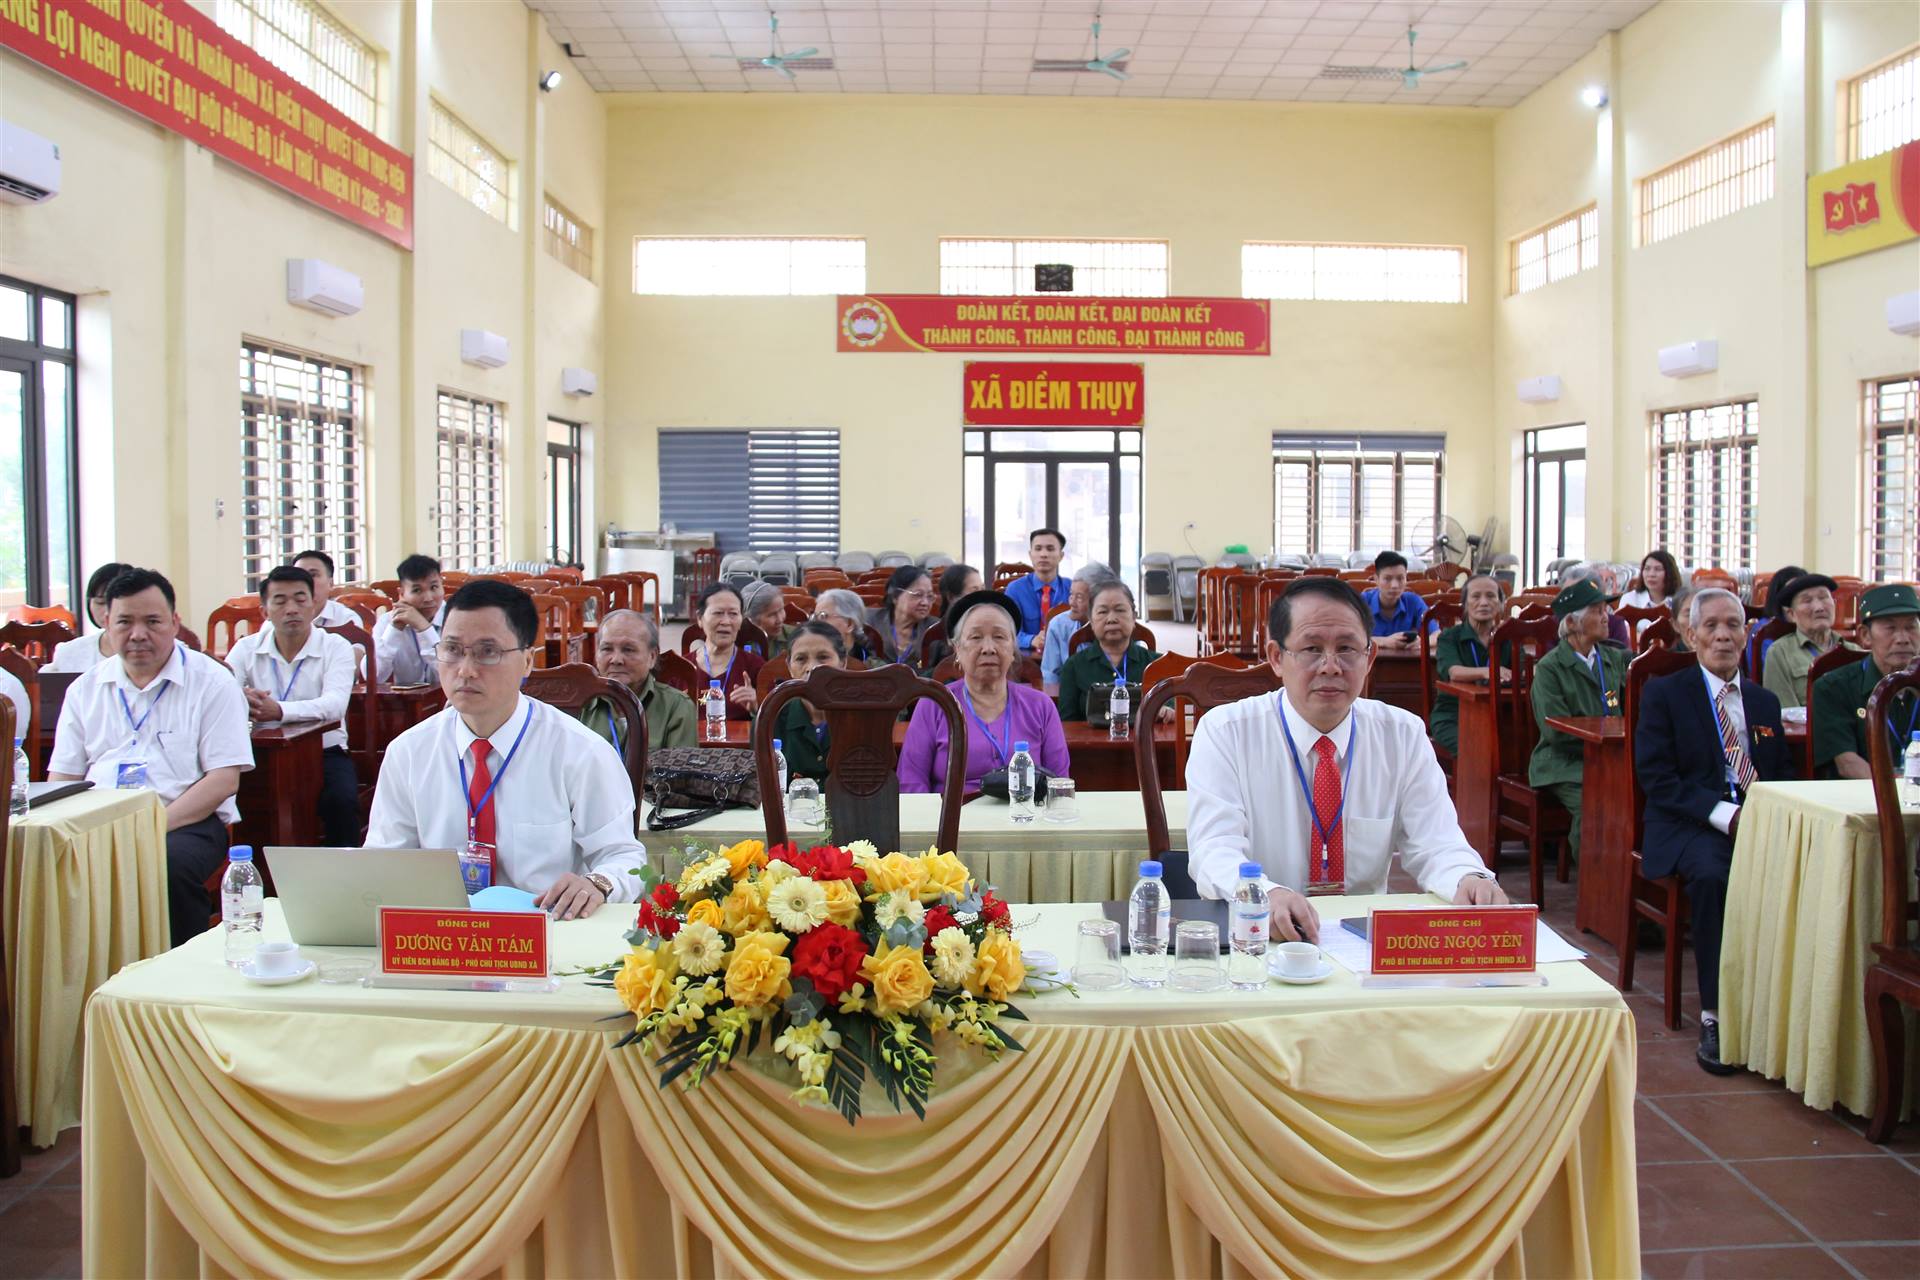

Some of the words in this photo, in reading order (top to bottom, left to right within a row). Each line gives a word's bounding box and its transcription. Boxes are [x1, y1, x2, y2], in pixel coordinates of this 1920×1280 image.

[176, 24, 195, 67] VÀ
[197, 38, 233, 89] NHÂN
[234, 62, 258, 105] DÂN
[259, 78, 275, 115] XÃ
[44, 2, 75, 59] LỢI
[79, 22, 121, 87] NGHỊ
[125, 50, 172, 105] QUYẾT
[173, 76, 197, 124] ĐẠI
[199, 91, 221, 137] HỘI
[222, 101, 255, 151] ĐẢNG
[256, 124, 272, 167] BỘ
[956, 301, 998, 321] ĐOÀN
[1001, 300, 1031, 323] KẾT,
[1035, 301, 1075, 321] ĐOÀN
[1079, 301, 1108, 323] KẾT,
[1112, 306, 1137, 326] ĐẠI
[1141, 303, 1181, 323] ĐOÀN
[1185, 302, 1212, 324] KẾT
[922, 325, 972, 345] THÀNH
[975, 325, 1021, 346] CÔNG,
[1024, 325, 1072, 345] THÀNH
[1076, 326, 1121, 347] CÔNG,
[1124, 329, 1149, 349] ĐẠI
[1154, 327, 1201, 347] THÀNH
[1205, 328, 1245, 347] CÔNG
[970, 373, 1003, 409] XÃ
[1009, 370, 1071, 409] ĐIỀM
[1077, 381, 1137, 416] THỤY
[395, 934, 453, 951] DƯƠNG
[457, 934, 492, 952] VĂN
[497, 934, 534, 953] TÁM
[1386, 934, 1440, 949] DƯƠNG
[1444, 935, 1486, 951] NGỌC
[1491, 931, 1523, 948] YÊN
